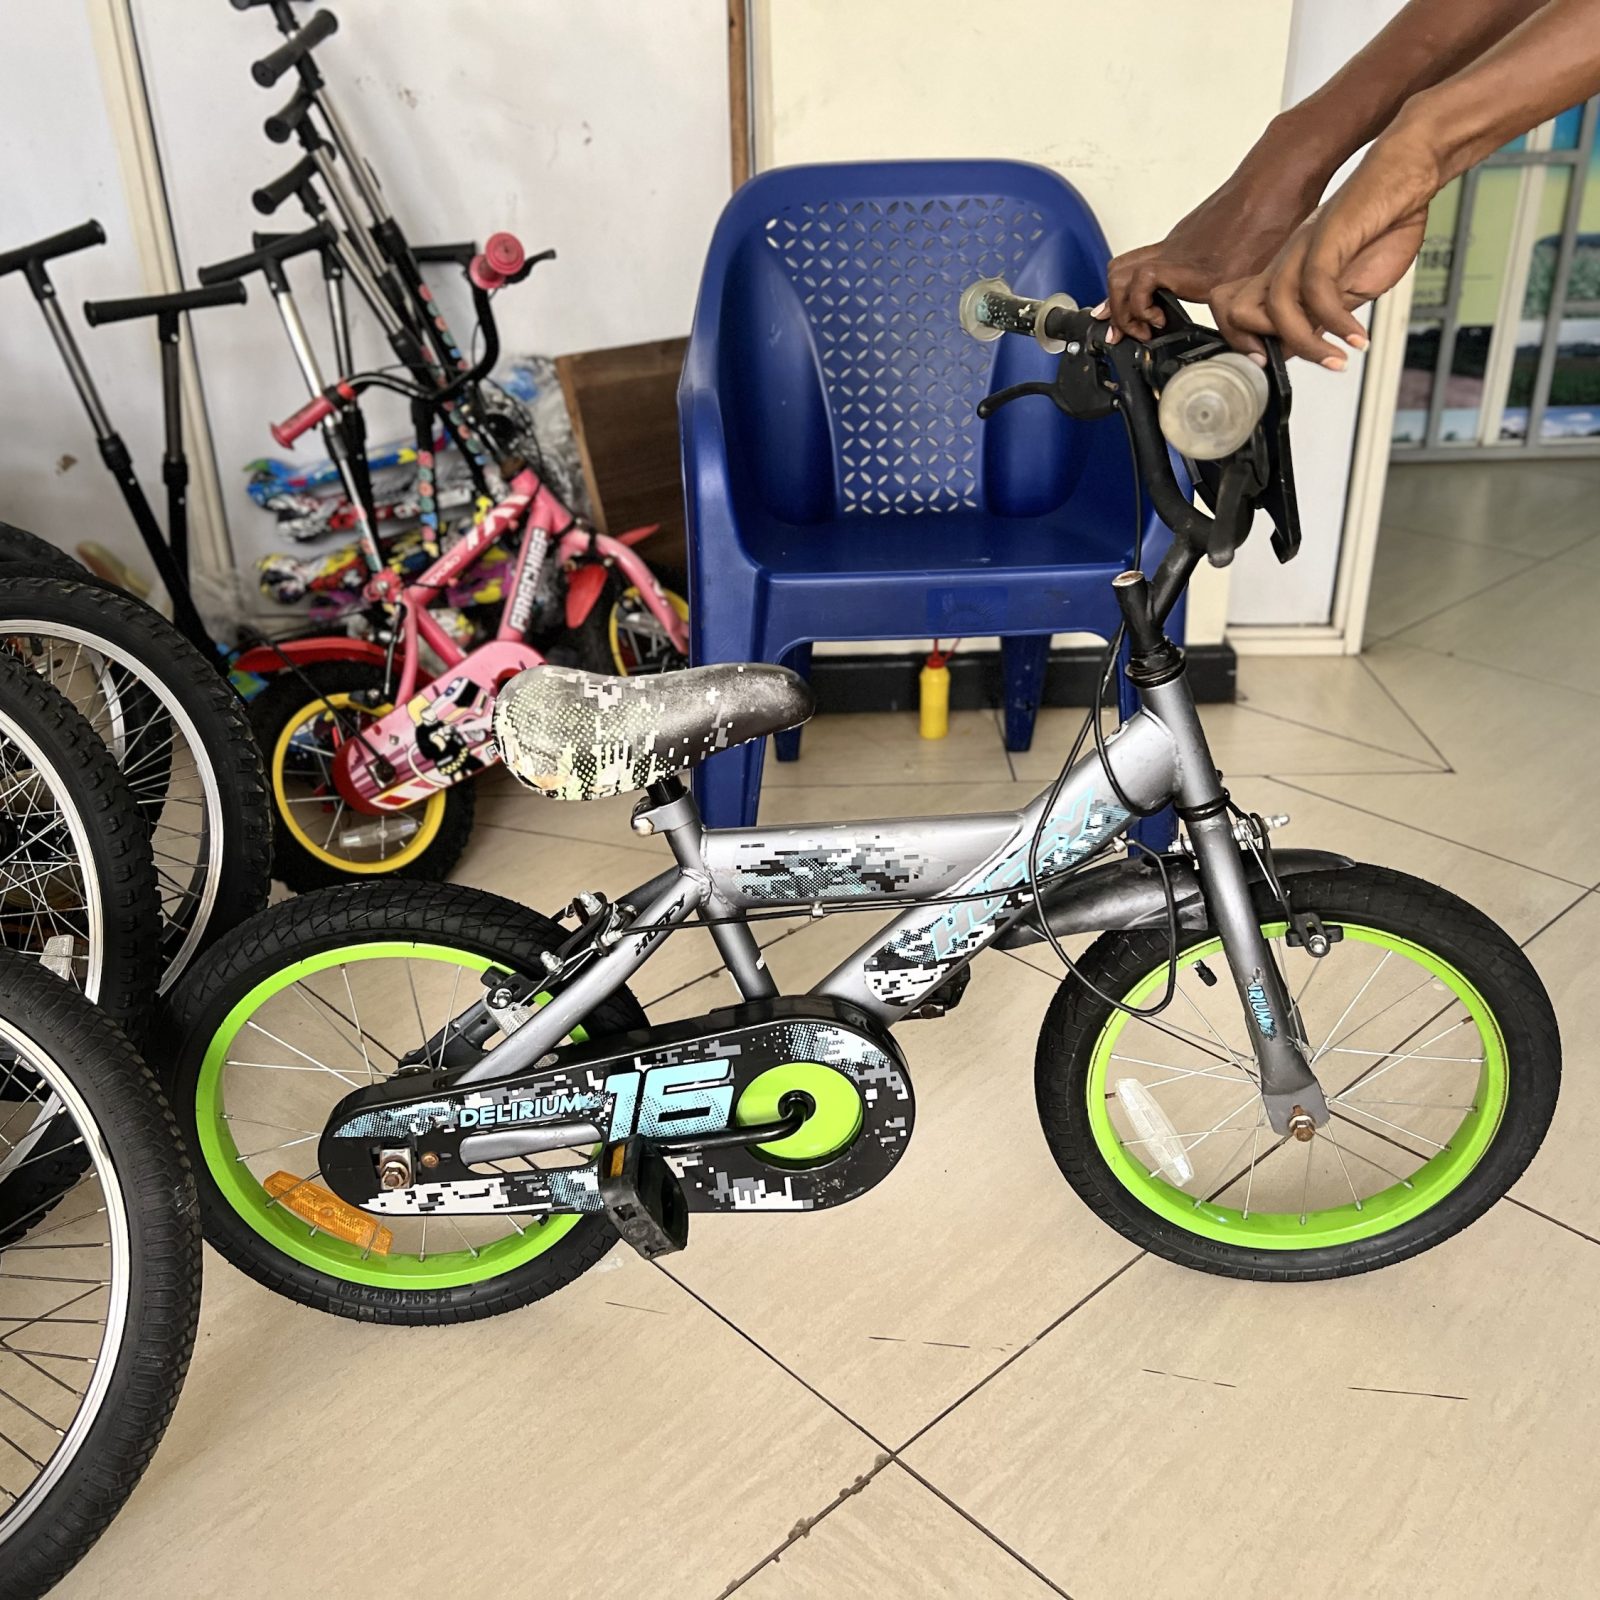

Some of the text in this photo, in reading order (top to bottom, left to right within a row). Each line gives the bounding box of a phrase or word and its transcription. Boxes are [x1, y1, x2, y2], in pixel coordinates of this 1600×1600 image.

[930, 787, 1094, 961] HUFFY
[459, 1092, 582, 1127] DELIRIUM
[605, 1059, 734, 1142] 16
